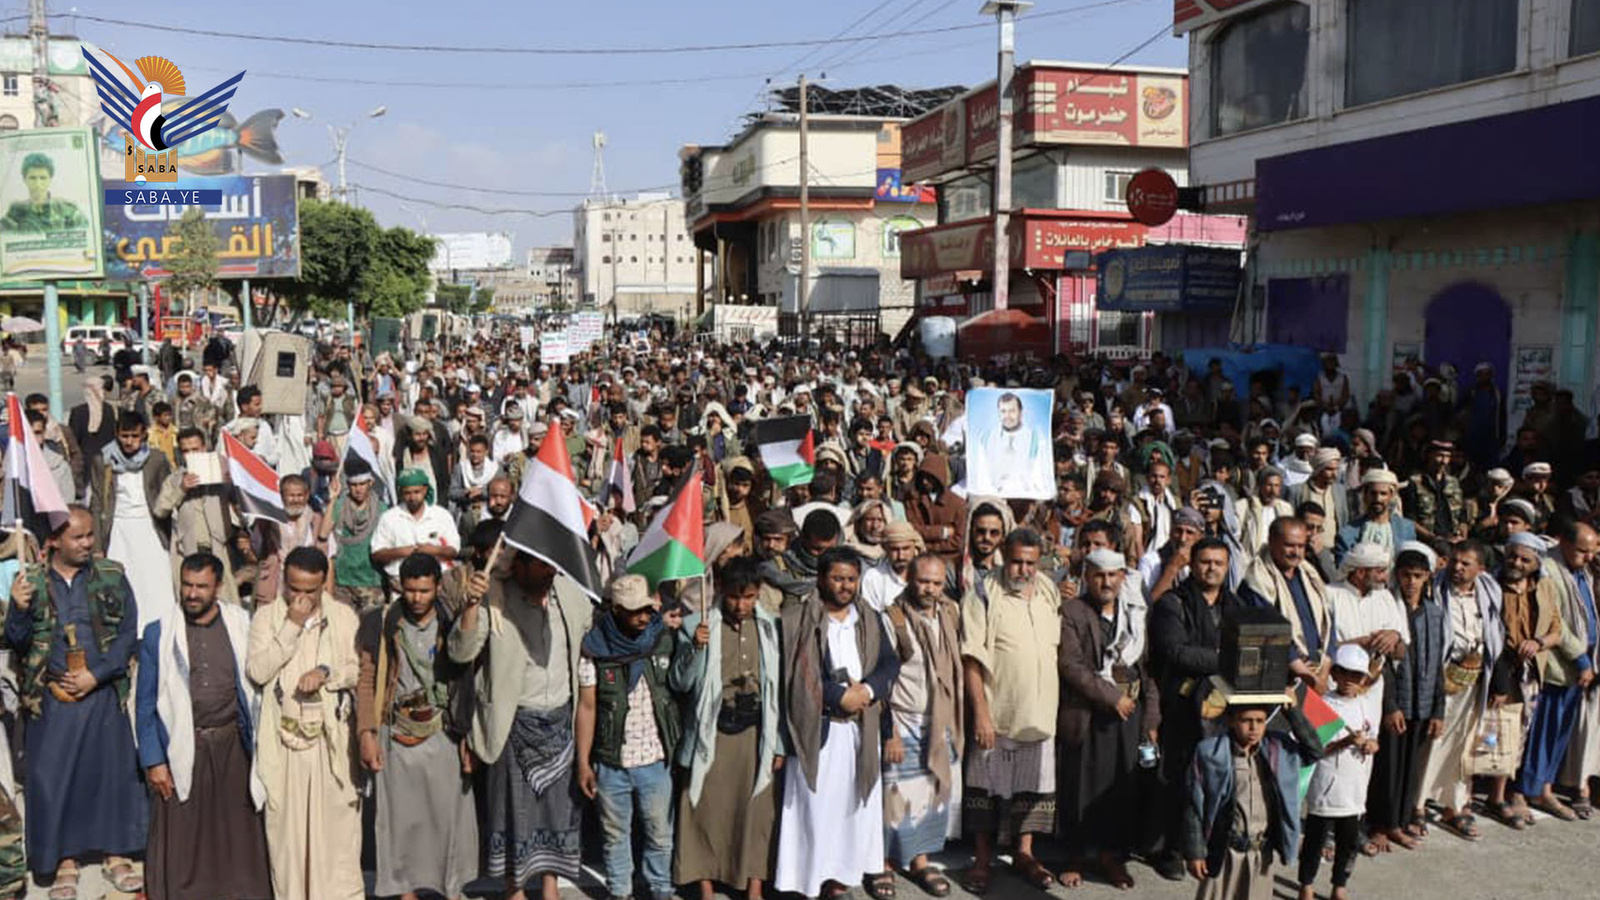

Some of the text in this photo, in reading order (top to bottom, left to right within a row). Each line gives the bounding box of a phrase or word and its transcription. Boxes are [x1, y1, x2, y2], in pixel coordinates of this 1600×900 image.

[1067, 77, 1129, 98] شبام
[1064, 102, 1128, 126] حضرموت
[123, 177, 262, 221] أسك
[116, 222, 272, 268] القي
[1090, 234, 1113, 250] خاص
[1115, 234, 1139, 248] قسم
